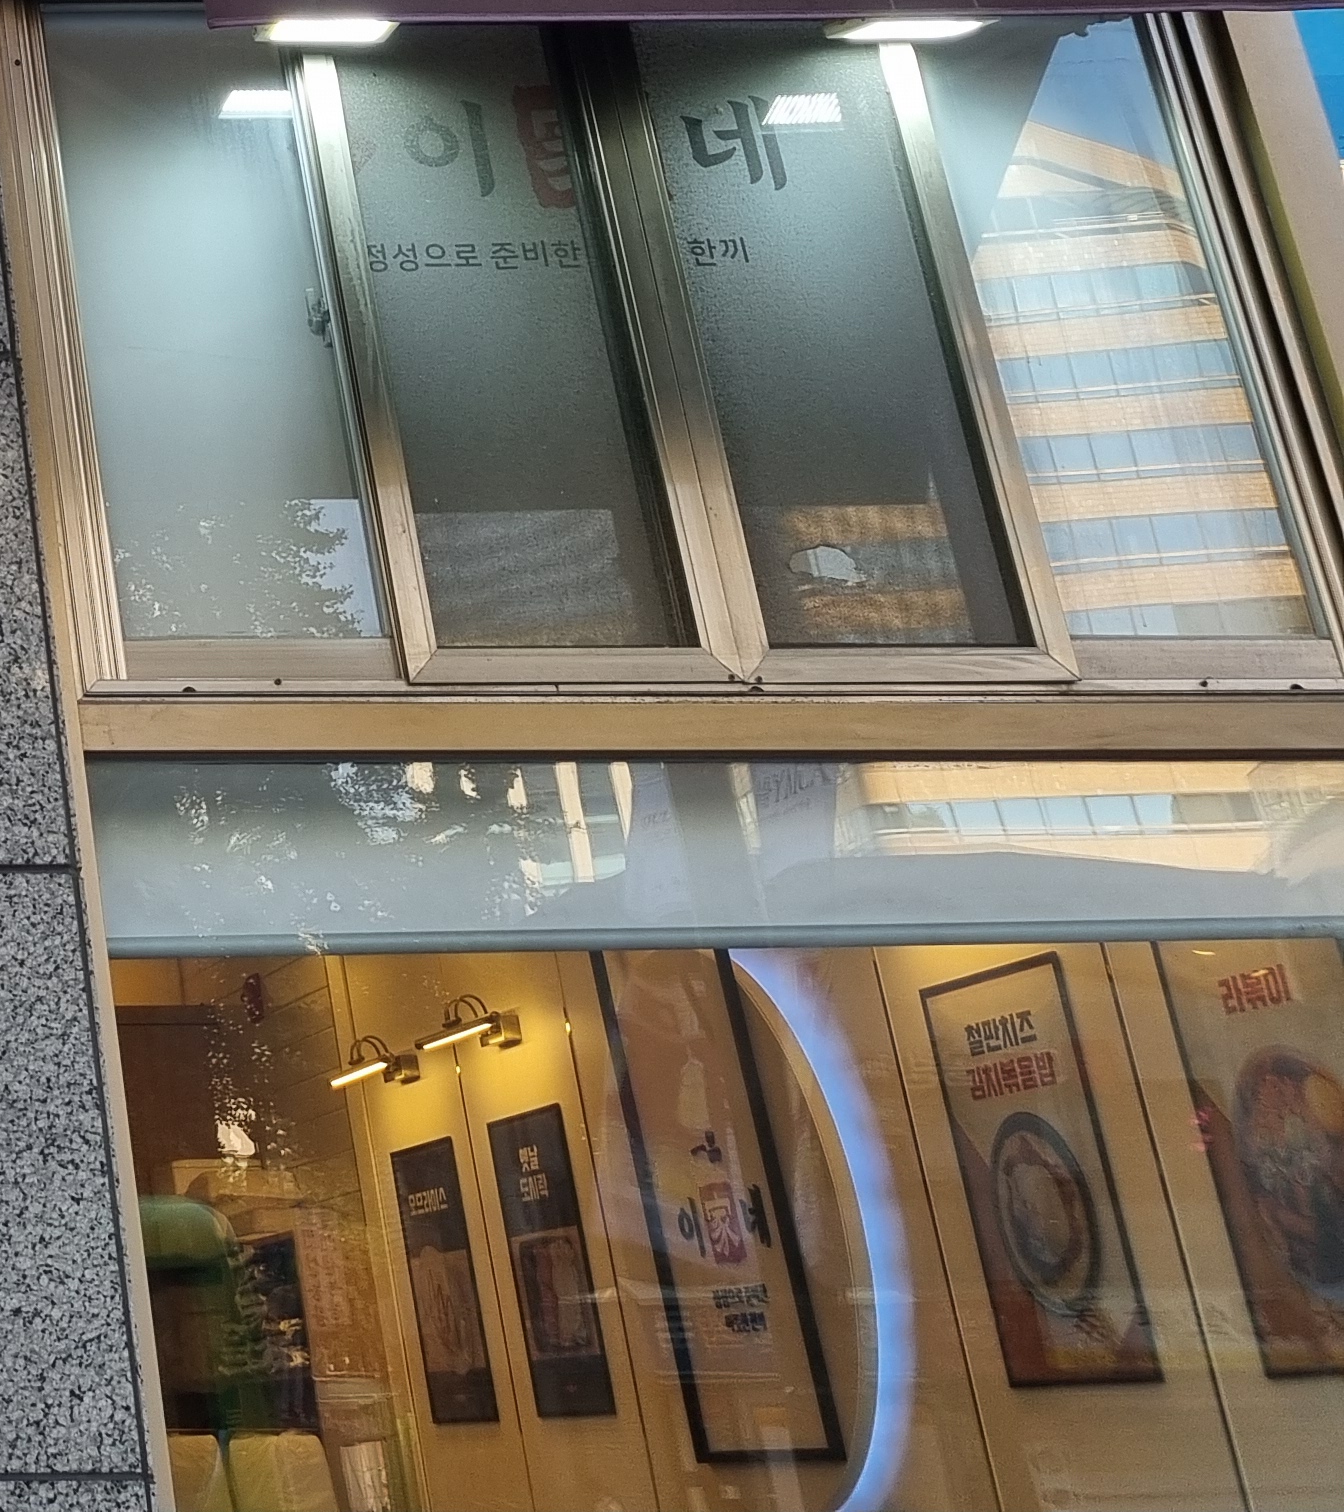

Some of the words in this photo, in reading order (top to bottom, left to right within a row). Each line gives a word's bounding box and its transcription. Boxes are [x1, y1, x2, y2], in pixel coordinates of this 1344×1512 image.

[367, 242, 482, 272] 정성으로
[490, 240, 582, 270] 준비한
[687, 236, 750, 266] 한끼
[1217, 964, 1292, 1015] 라볶이
[964, 1010, 1038, 1057] 철판치즈
[965, 1051, 1058, 1101] 김치볶음밥
[518, 1143, 540, 1173] 옛날
[519, 1172, 549, 1203] 도시락
